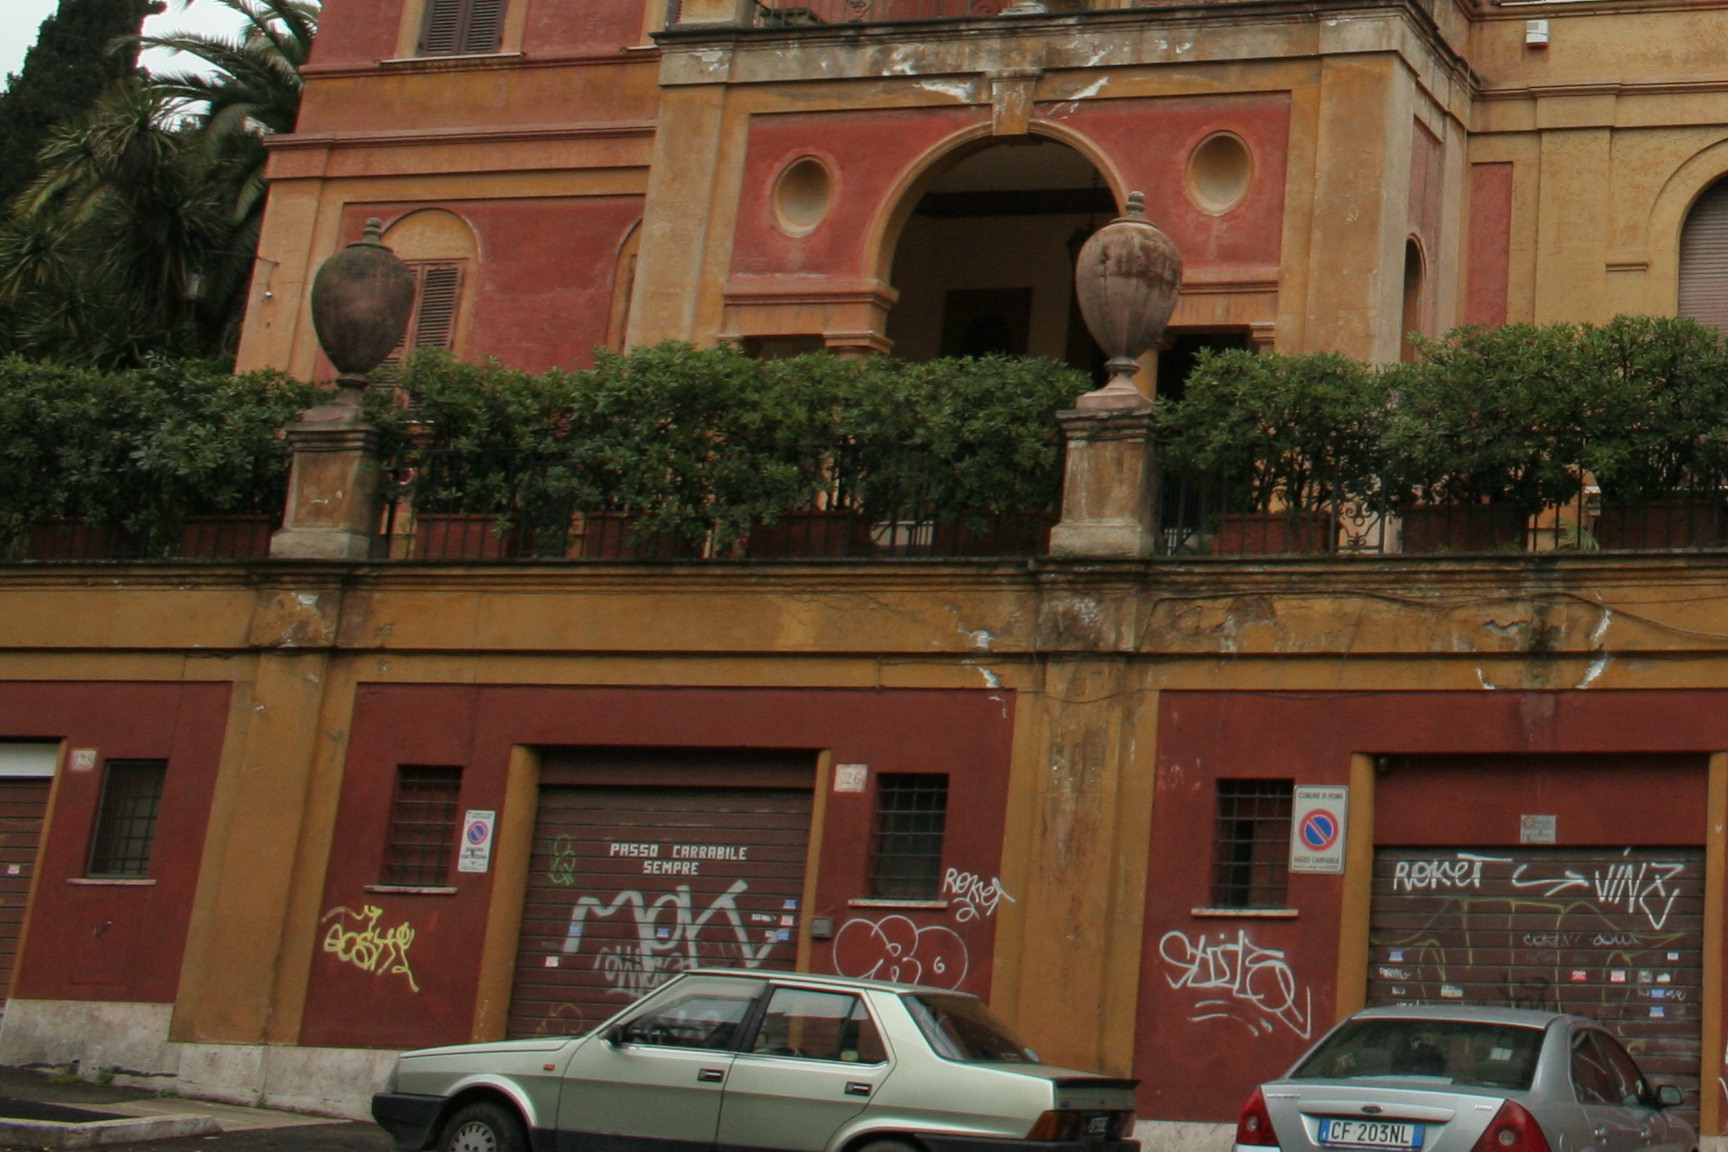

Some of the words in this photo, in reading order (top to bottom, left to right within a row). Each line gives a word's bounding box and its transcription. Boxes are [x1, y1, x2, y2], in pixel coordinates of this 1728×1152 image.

[610, 843, 659, 858] PASSO
[673, 845, 748, 861] CARRABILE
[643, 860, 699, 875] SEMPRE
[1330, 1121, 1353, 1140] CF
[1357, 1123, 1410, 1145] 203NL
